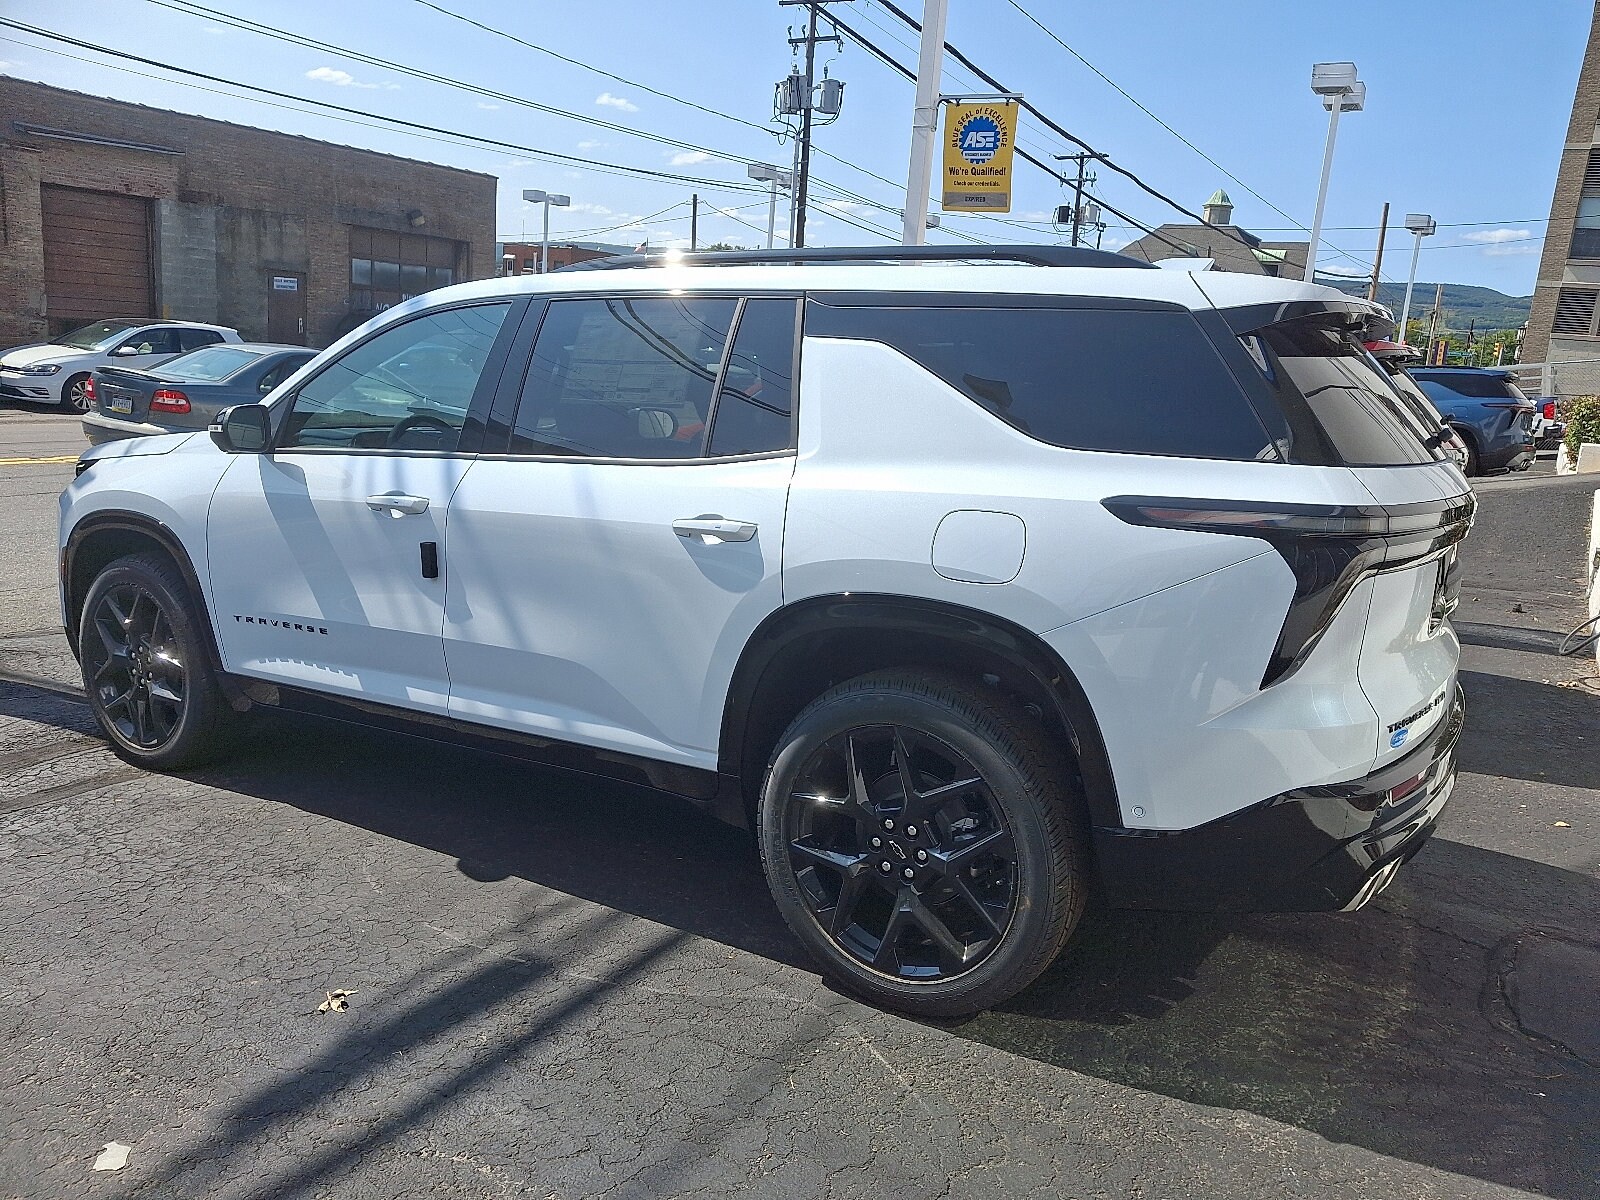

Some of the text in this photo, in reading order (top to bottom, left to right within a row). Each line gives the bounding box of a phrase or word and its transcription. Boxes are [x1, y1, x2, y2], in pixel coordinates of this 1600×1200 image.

[951, 107, 1008, 148] BLUE SEAL of EXCELLENCE
[963, 131, 995, 148] ASE
[949, 166, 1007, 176] We're Qualified!
[964, 195, 986, 203] EXPIRED
[233, 614, 329, 636] TRAVERSE
